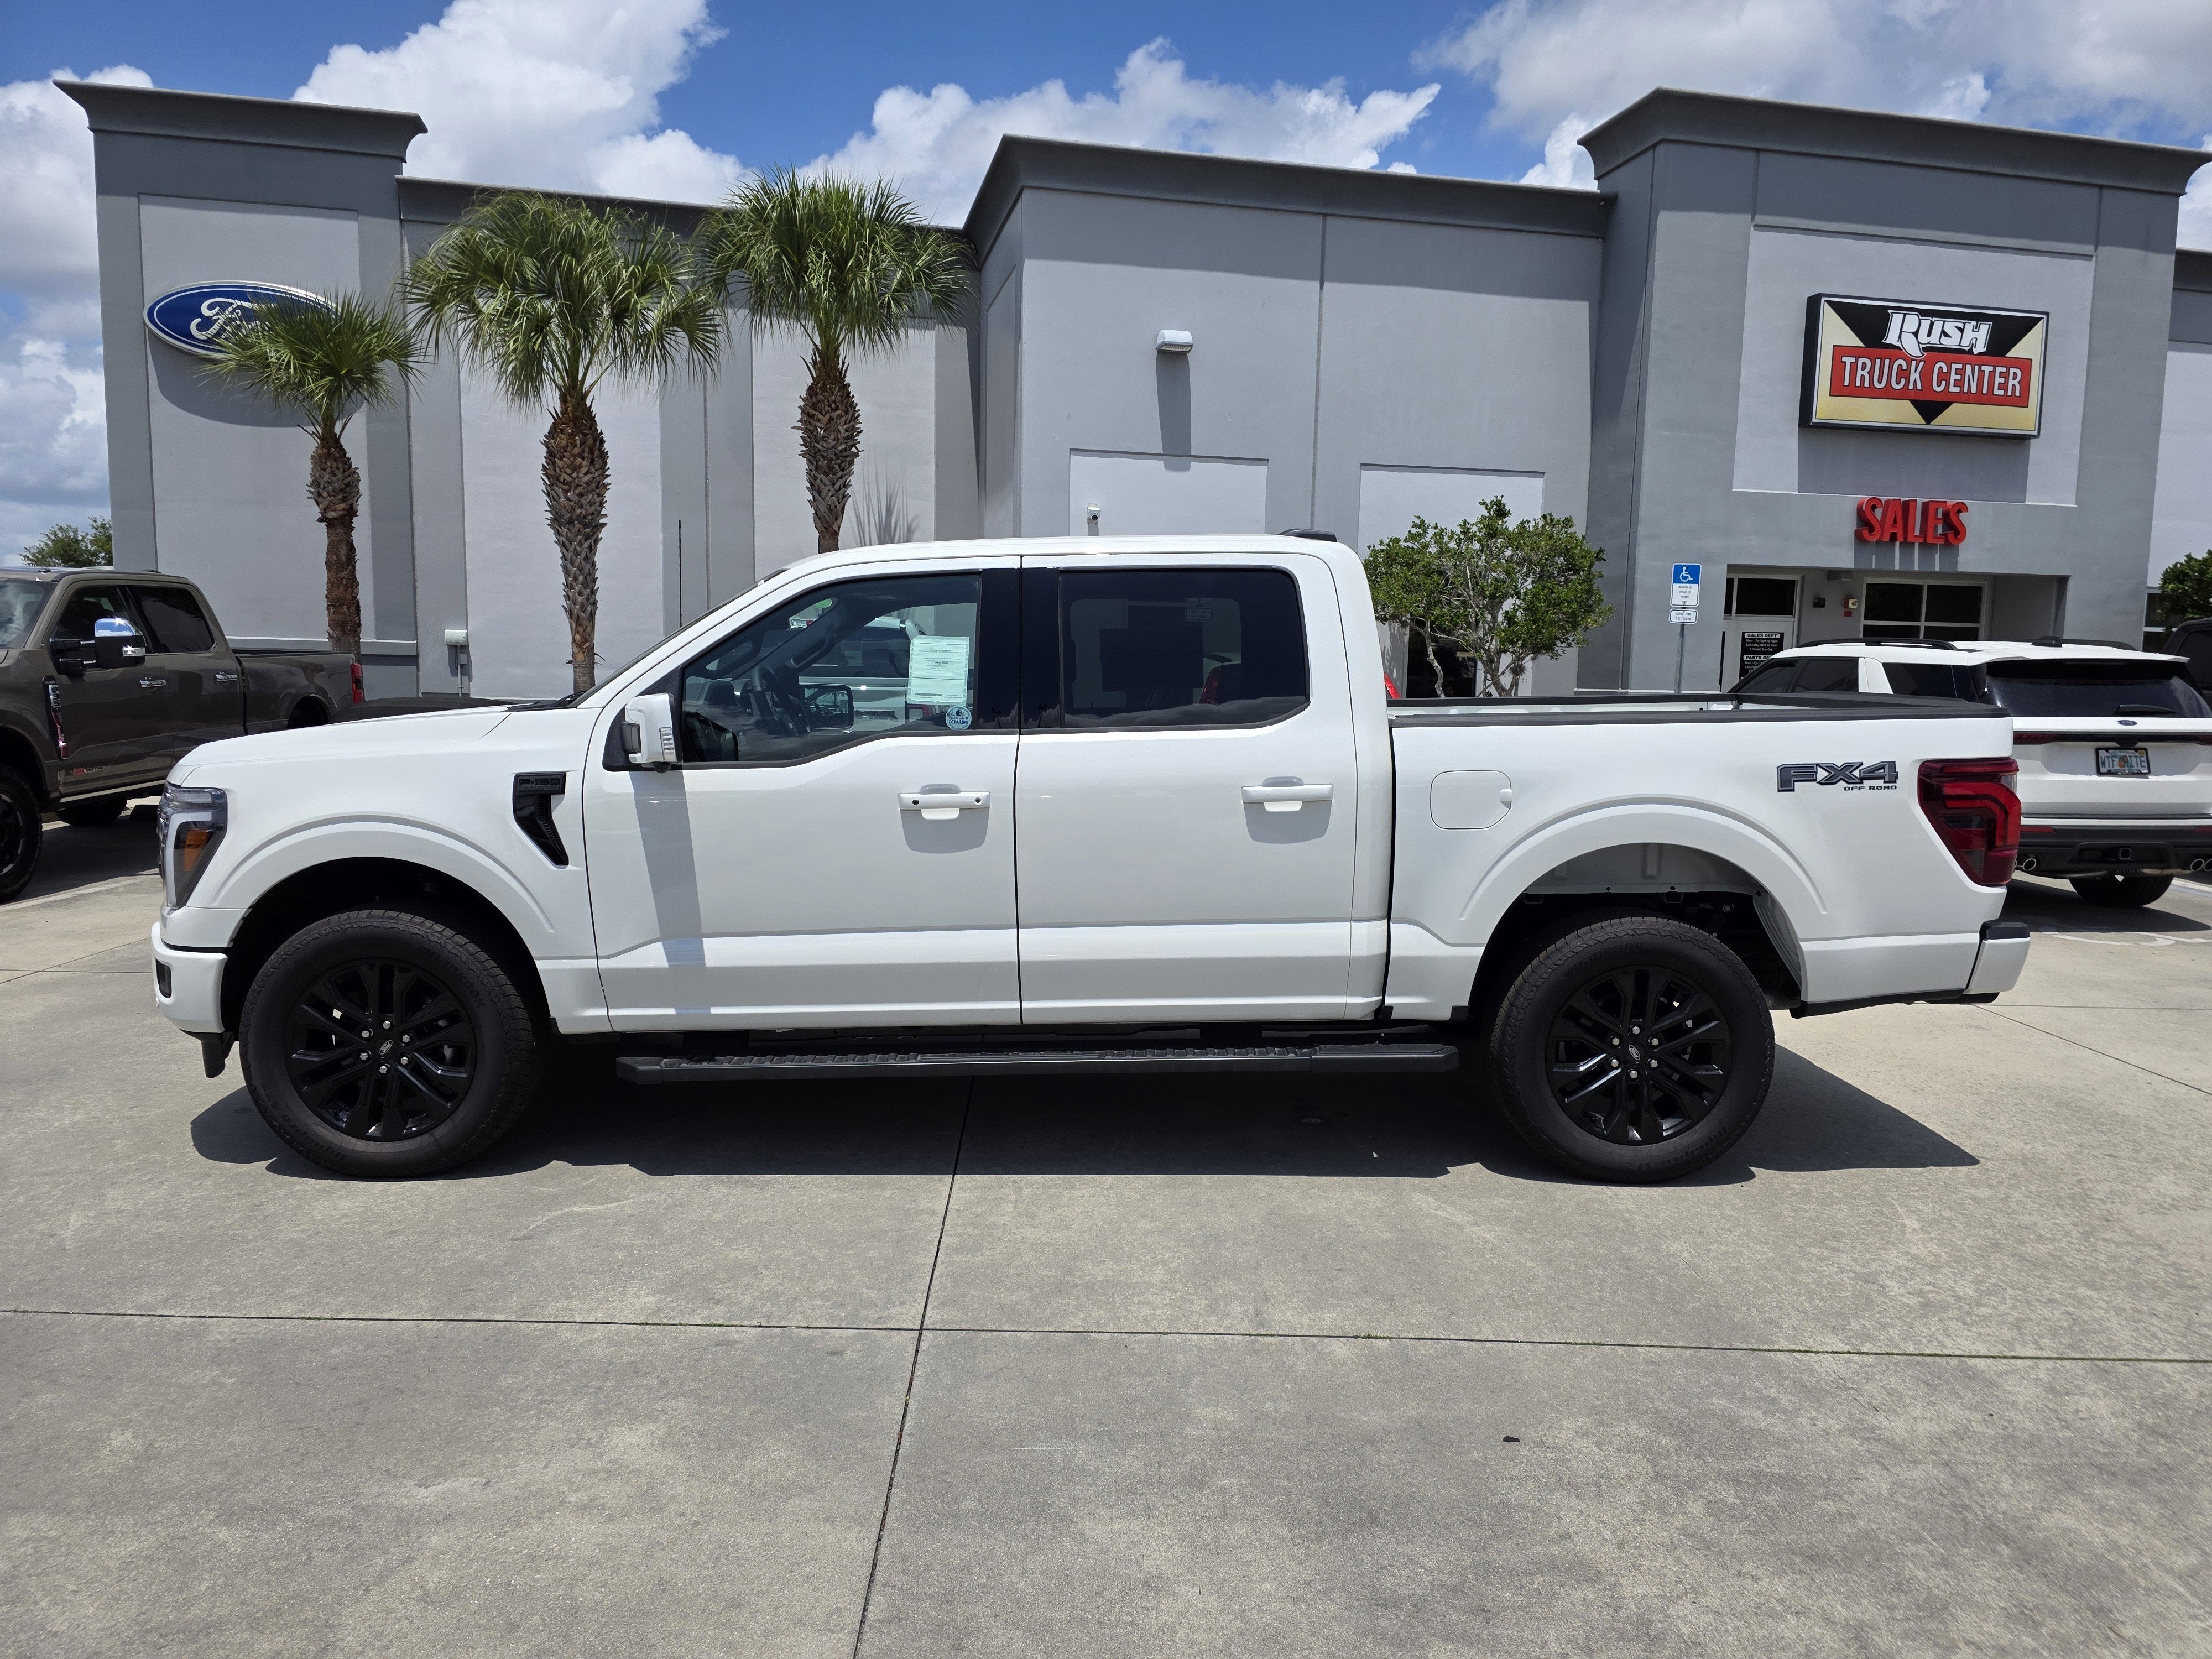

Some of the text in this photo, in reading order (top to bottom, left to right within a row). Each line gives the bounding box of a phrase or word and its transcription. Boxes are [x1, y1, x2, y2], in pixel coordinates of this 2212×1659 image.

[1881, 309, 1993, 358] RUSH
[1841, 356, 2022, 397] TRUCK CENTER
[1854, 497, 1969, 545] SALES
[518, 778, 561, 786] F-150
[1777, 761, 1898, 792] FX4
